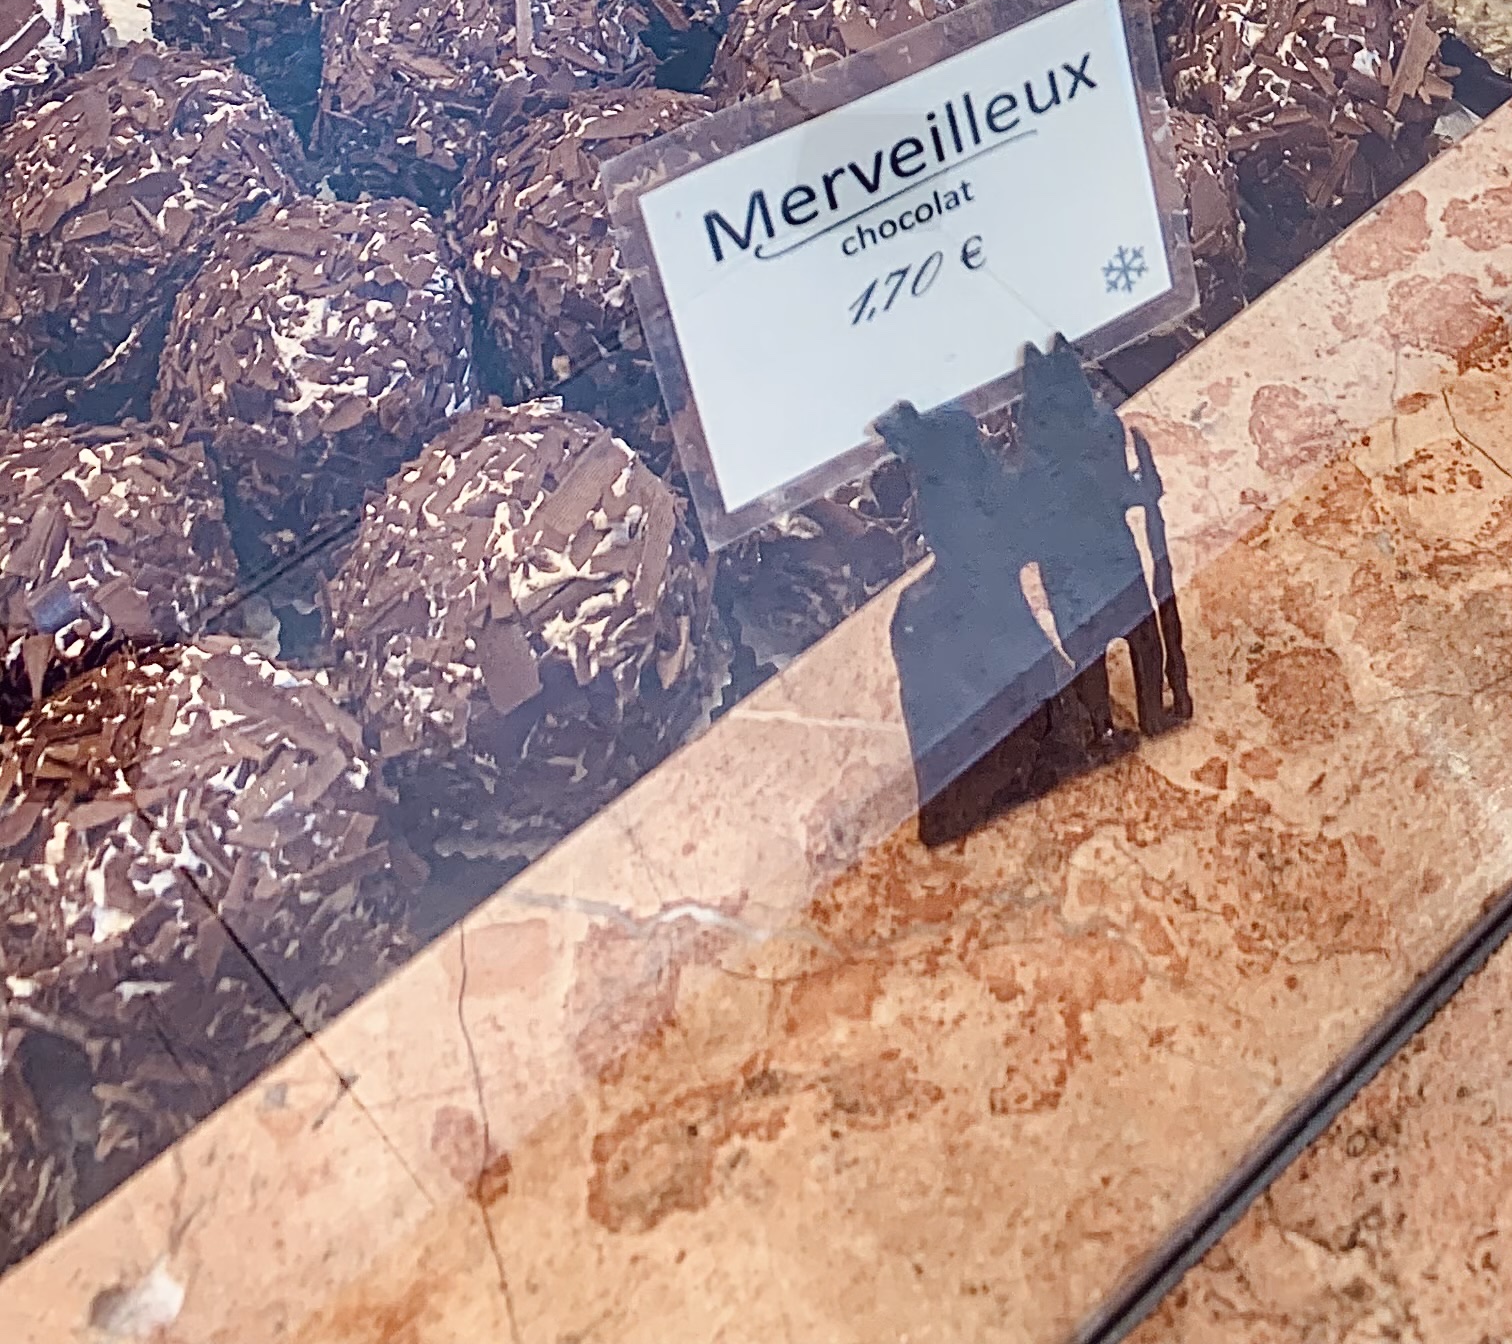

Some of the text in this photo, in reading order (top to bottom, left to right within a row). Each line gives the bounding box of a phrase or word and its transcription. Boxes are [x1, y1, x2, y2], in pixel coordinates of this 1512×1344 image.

[704, 52, 1098, 262] Merveilleux
[841, 179, 976, 256] chocolat
[848, 235, 986, 326] 1,70 €
